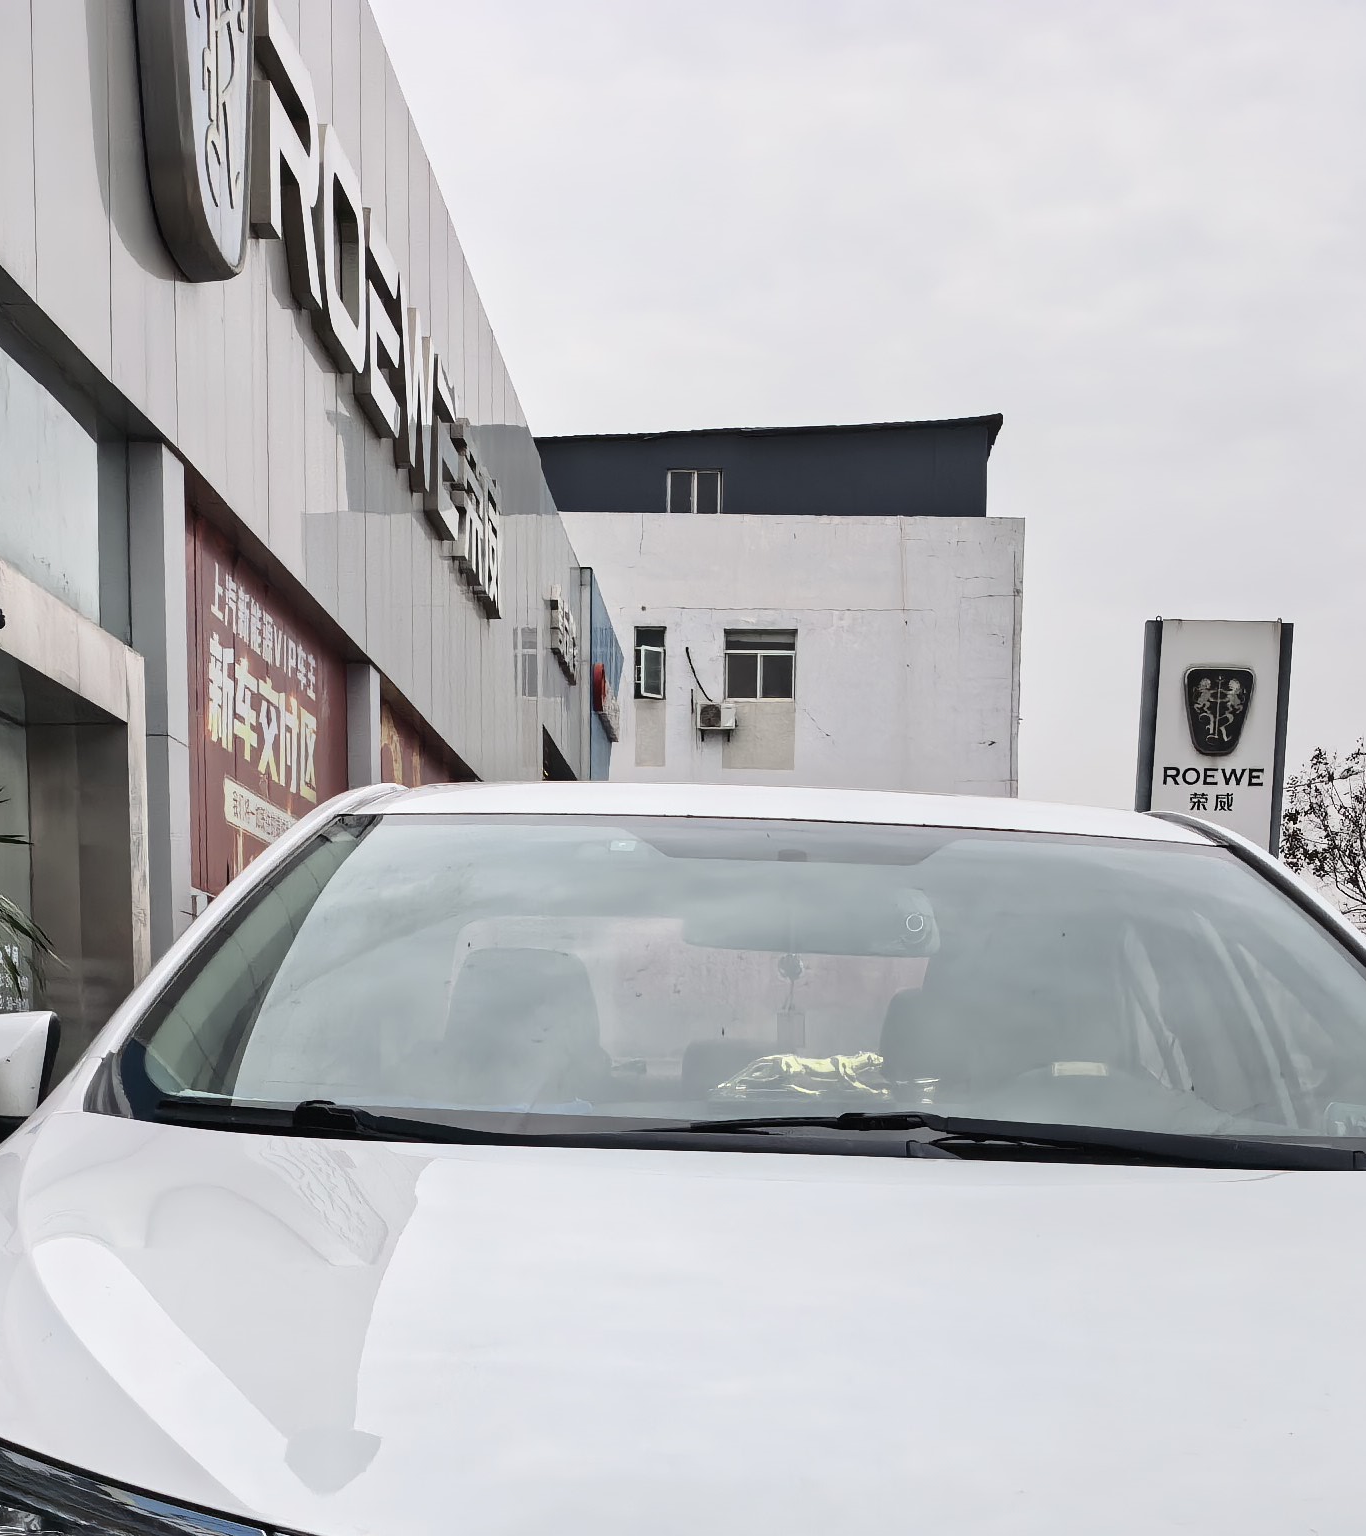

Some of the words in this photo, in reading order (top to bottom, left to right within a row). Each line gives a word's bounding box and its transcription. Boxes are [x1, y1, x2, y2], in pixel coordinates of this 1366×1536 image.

[251, 0, 458, 541] ROEWE
[210, 561, 316, 702] 上汽新能源VIP车主
[207, 631, 317, 804] 新车交付区
[1163, 766, 1265, 787] ROEWE
[1189, 792, 1234, 812] 荣威
